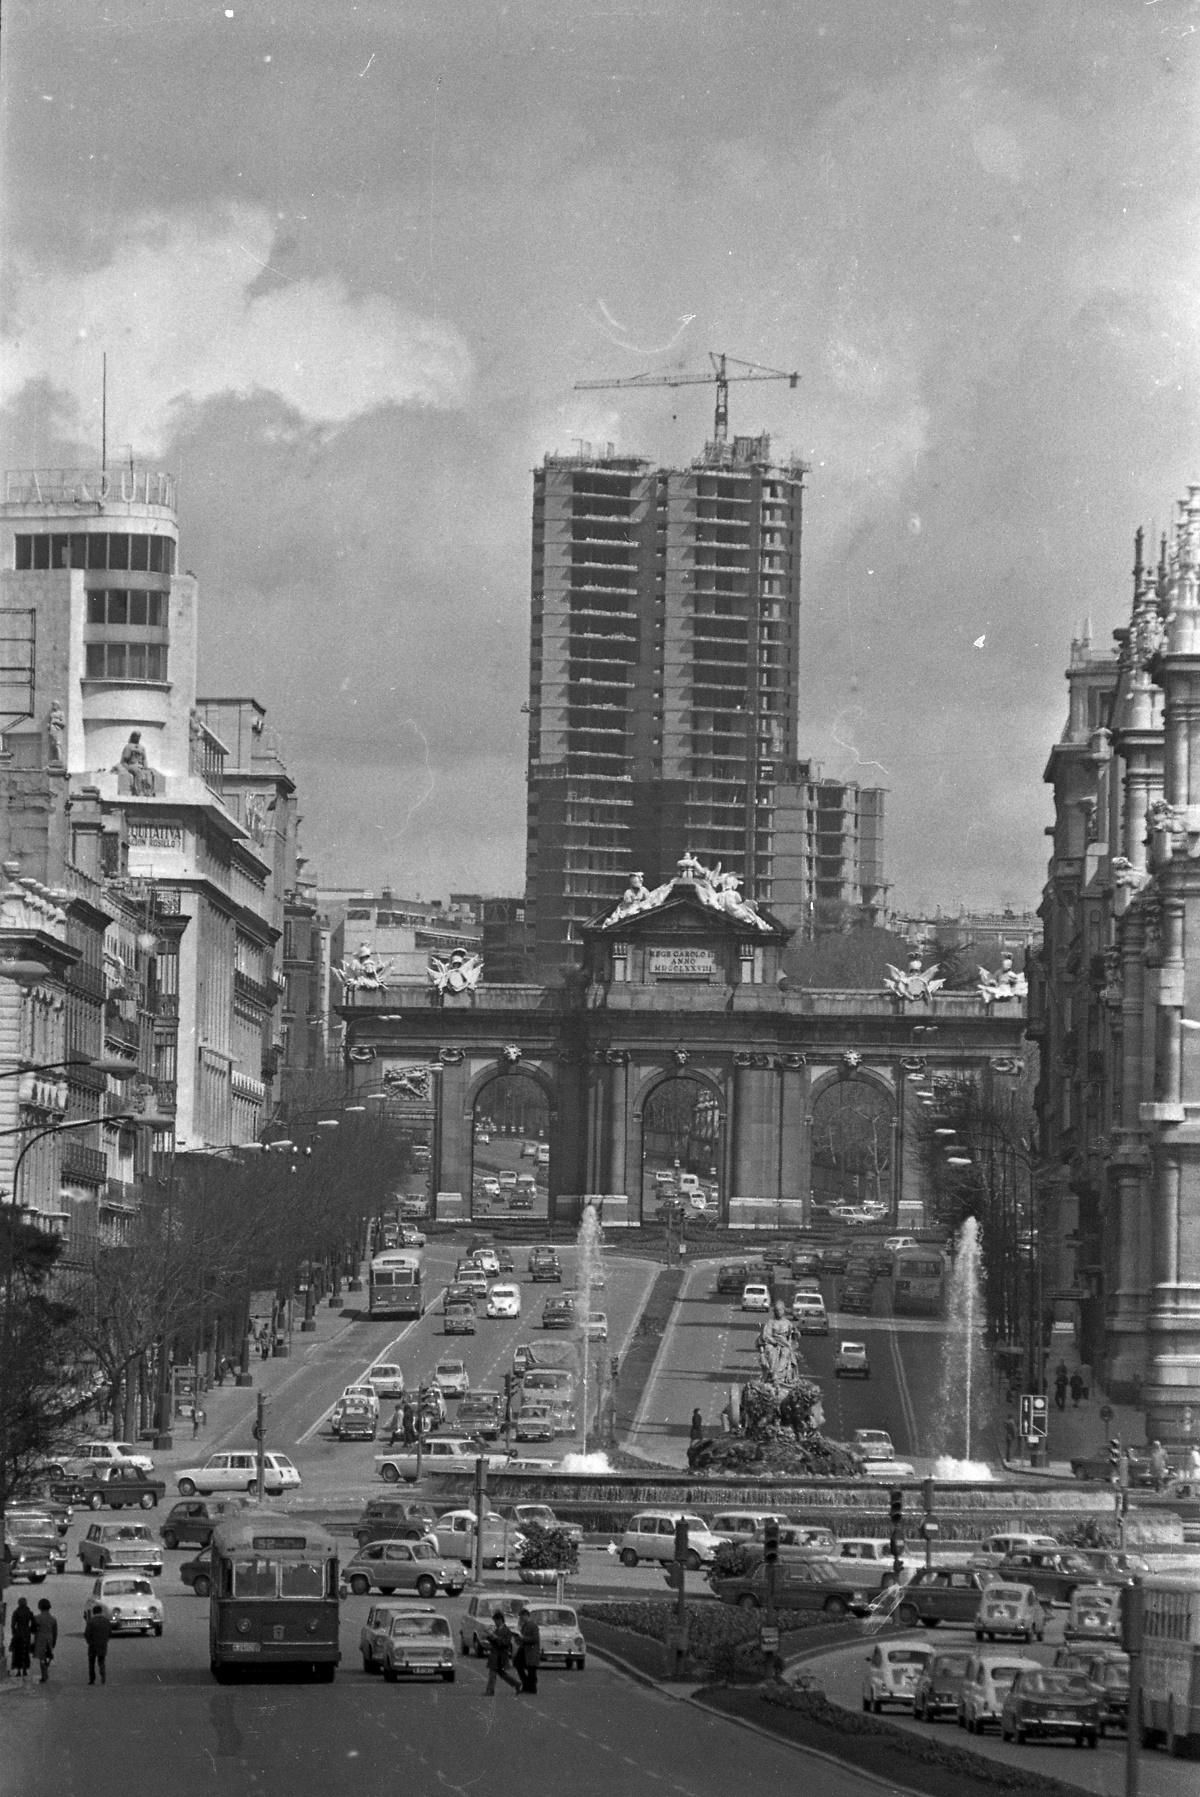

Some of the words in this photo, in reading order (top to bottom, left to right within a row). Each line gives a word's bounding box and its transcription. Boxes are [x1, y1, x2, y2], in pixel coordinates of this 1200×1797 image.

[128, 823, 181, 840] QUITATIVA
[650, 950, 671, 958] REGE
[673, 950, 706, 959] CAROLO
